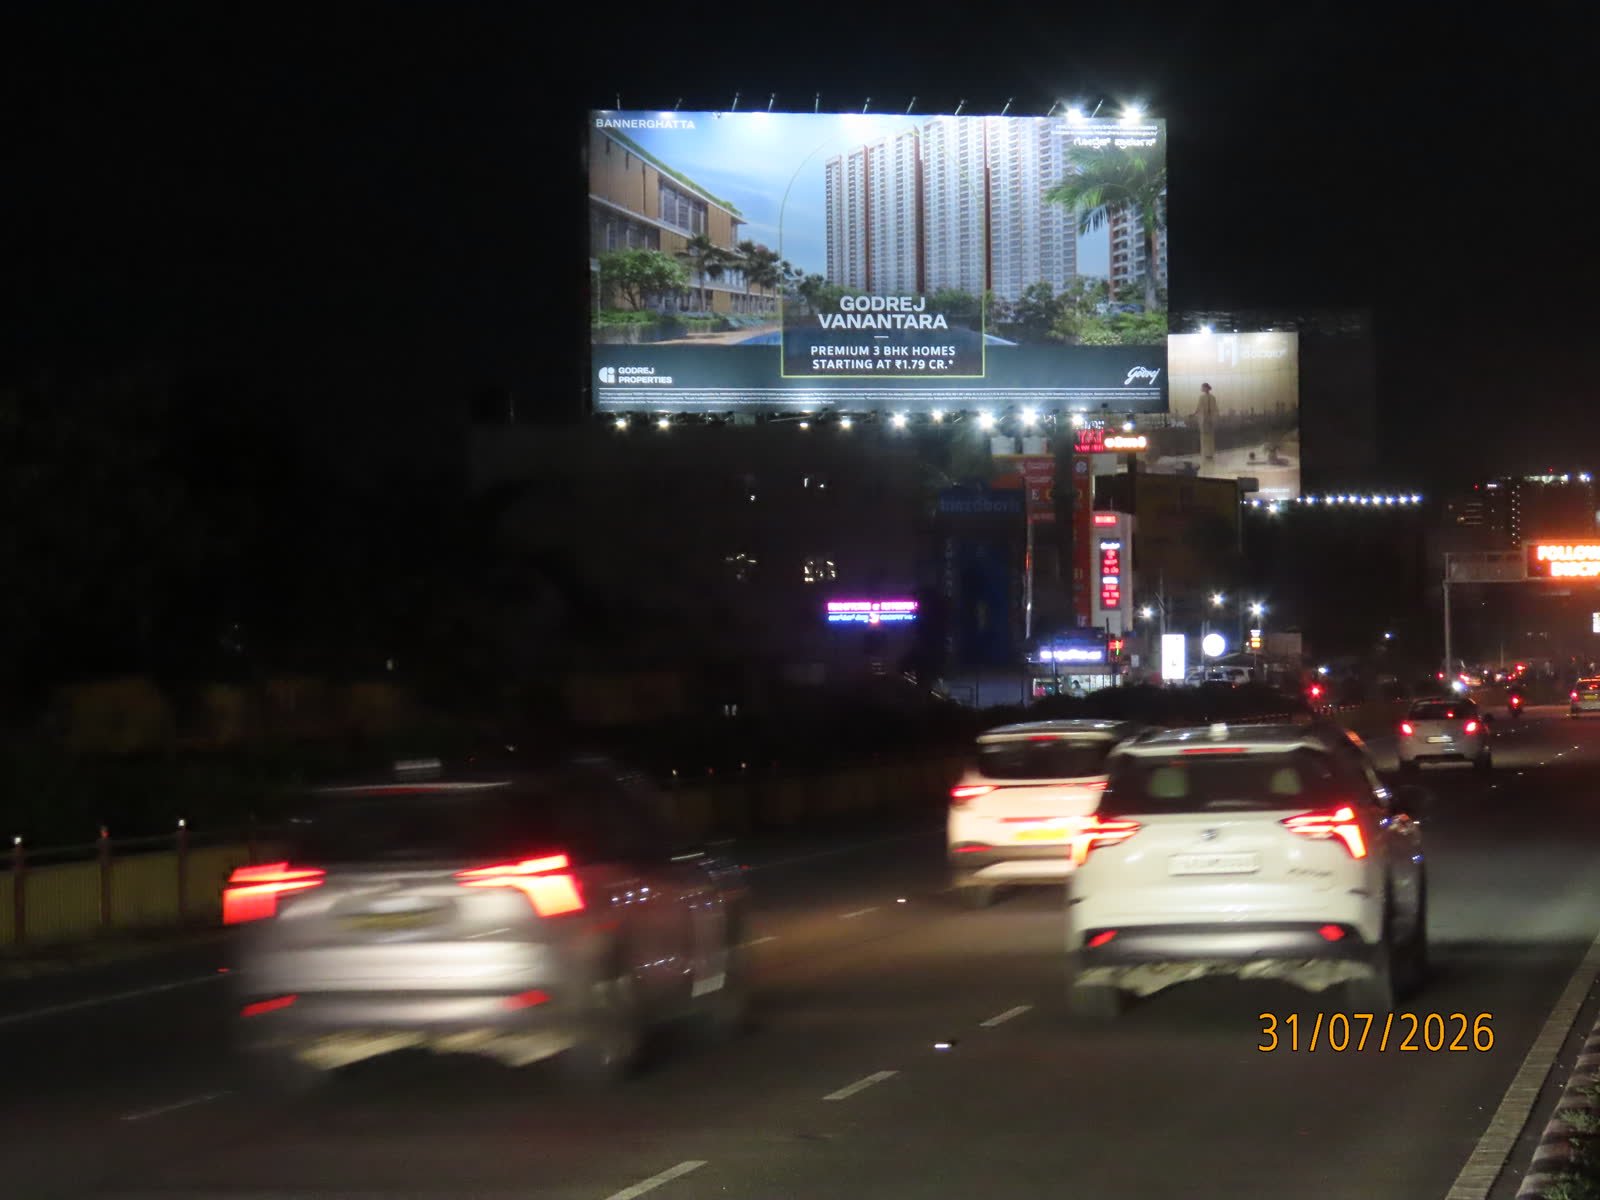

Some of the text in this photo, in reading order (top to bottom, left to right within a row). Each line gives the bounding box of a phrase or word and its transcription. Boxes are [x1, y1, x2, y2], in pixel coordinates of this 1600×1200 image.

[595, 118, 696, 130] BANNERGHATTA
[839, 295, 926, 312] GODREJ
[817, 313, 949, 330] VANANTARA
[810, 345, 956, 357] PREMIUM 3 BHK HOMES
[618, 366, 655, 375] GODREJ
[812, 359, 873, 370] STARTING
[876, 359, 892, 370] AT
[894, 359, 926, 371] ₹1.79
[618, 375, 673, 385] PROPERTIES
